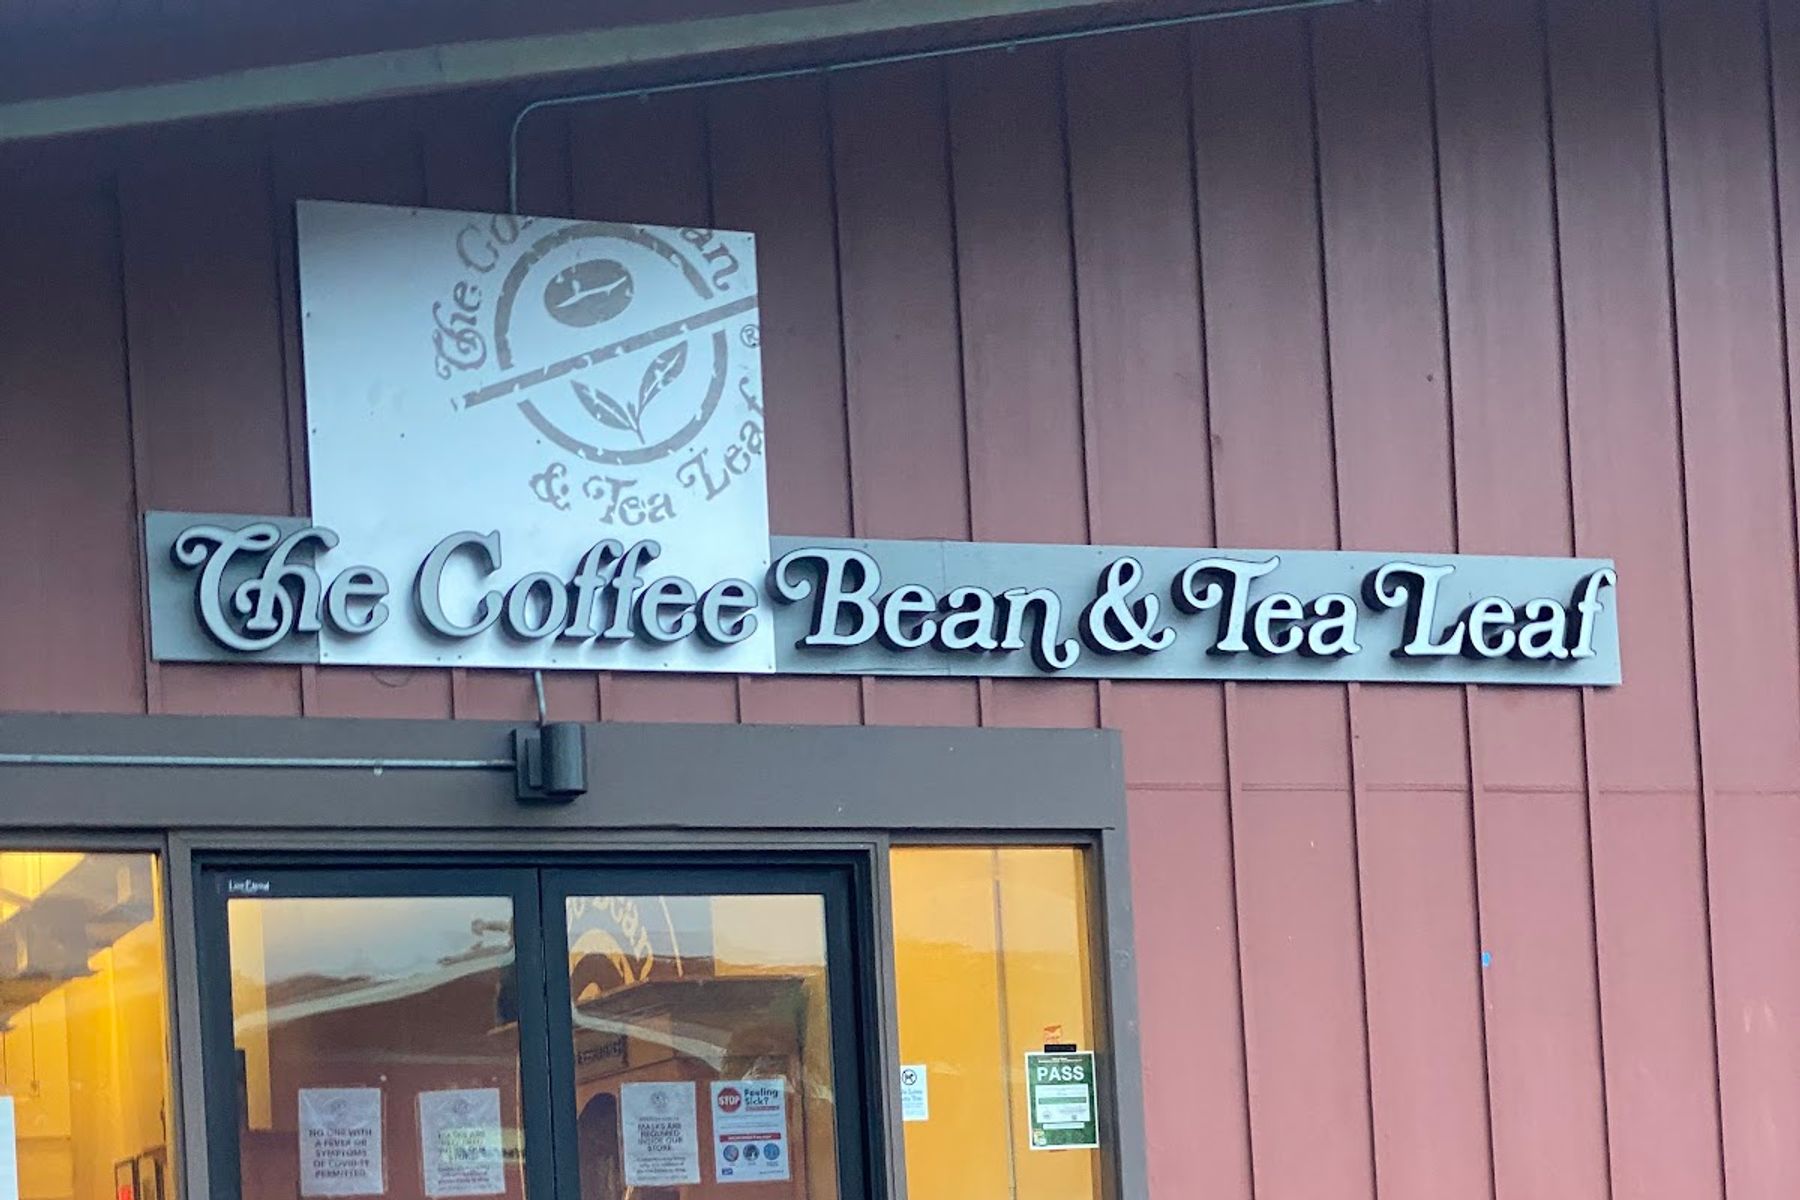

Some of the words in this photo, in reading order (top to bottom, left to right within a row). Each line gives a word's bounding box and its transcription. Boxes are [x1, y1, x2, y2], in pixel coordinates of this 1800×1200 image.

[432, 280, 488, 380] The
[528, 462, 571, 512] &
[582, 475, 677, 526] Tea
[170, 523, 389, 653] The
[413, 530, 759, 646] Coffee
[766, 547, 1080, 672] Bean
[1079, 556, 1176, 656] &
[1171, 555, 1364, 657] Tea
[1362, 559, 1618, 661] Leaf
[1037, 1065, 1085, 1082] PASS
[718, 1094, 740, 1106] STOP
[744, 1088, 779, 1098] Feeling
[745, 1096, 769, 1106] Sick?
